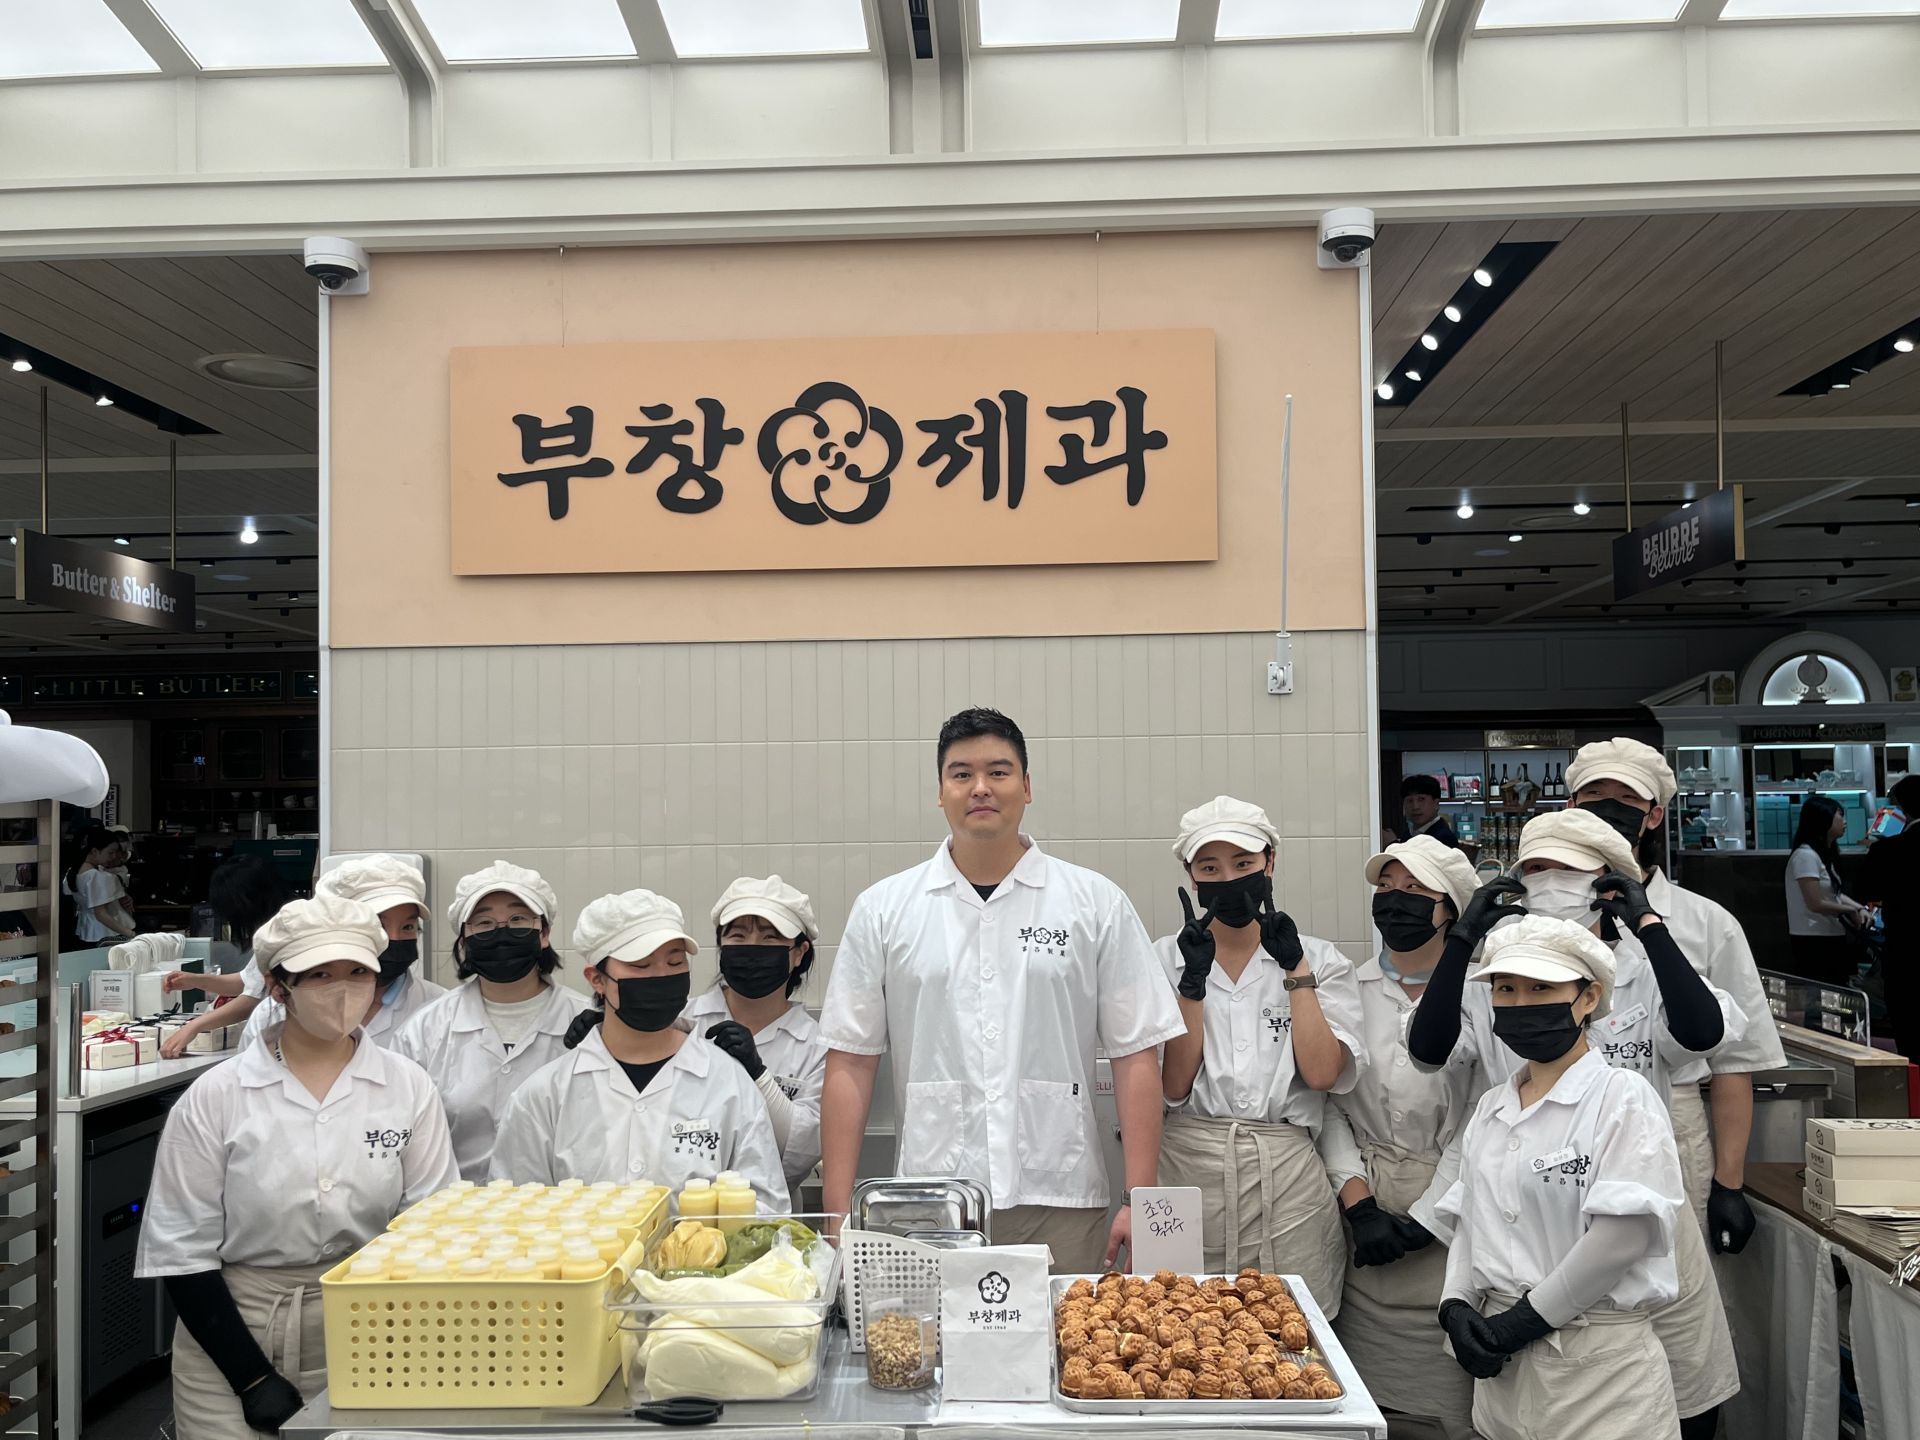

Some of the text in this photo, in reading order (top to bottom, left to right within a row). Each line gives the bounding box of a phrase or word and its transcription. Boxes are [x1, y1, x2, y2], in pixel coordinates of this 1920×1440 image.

[497, 386, 1168, 521] 부창 제과
[52, 563, 177, 614] Butter & Shelter
[52, 677, 266, 696] LITTLE BUTLER
[967, 1309, 1022, 1324] 부창제과
